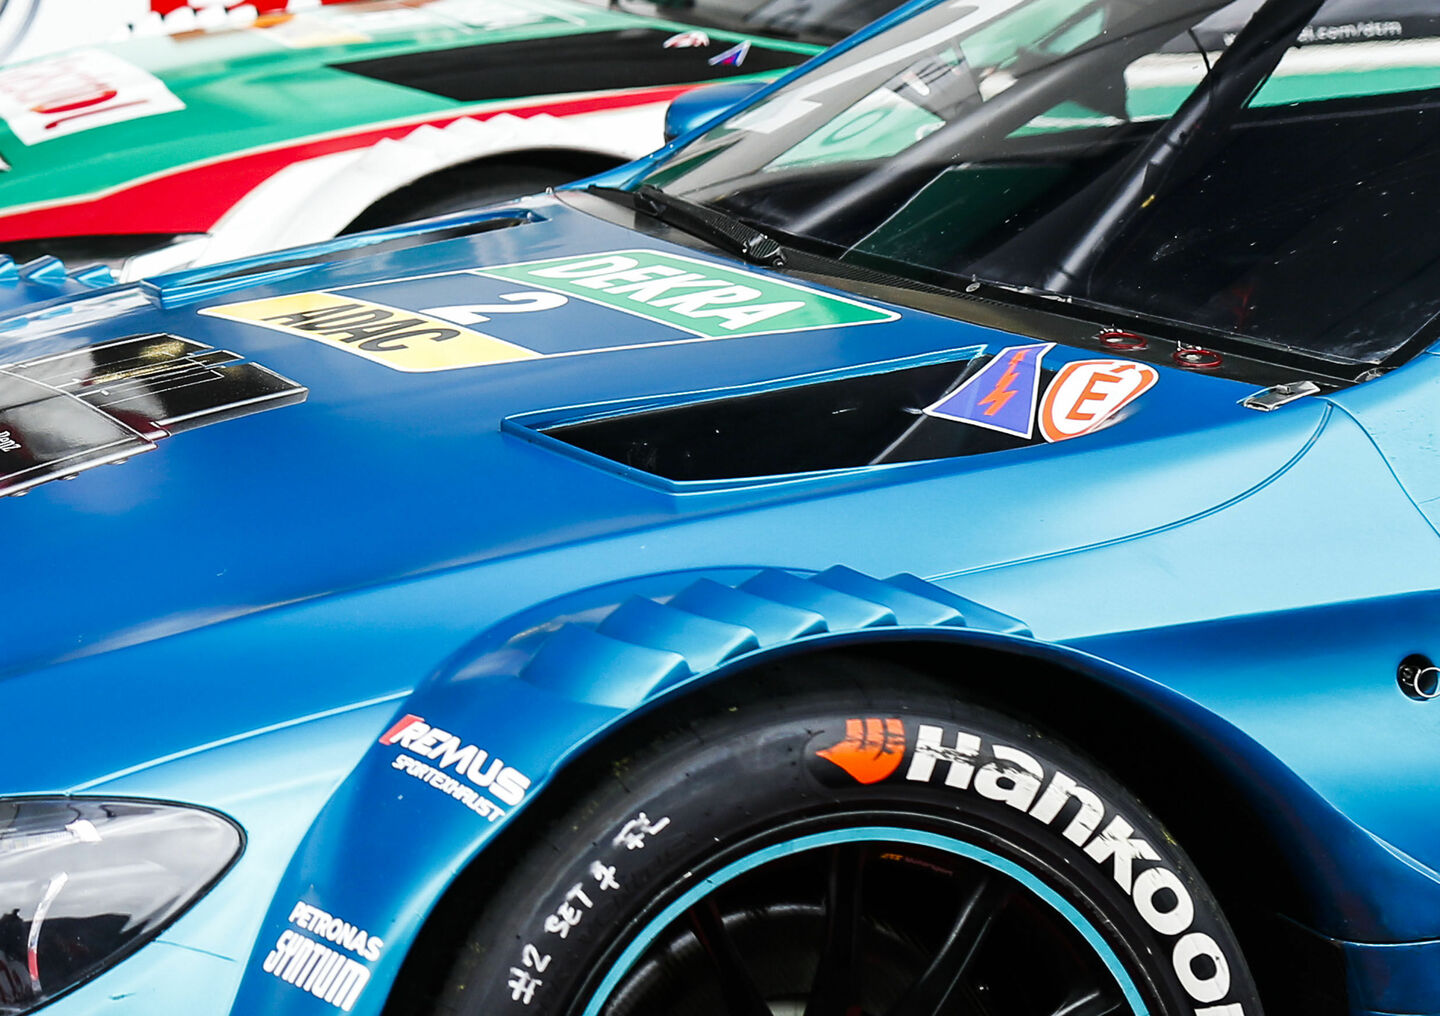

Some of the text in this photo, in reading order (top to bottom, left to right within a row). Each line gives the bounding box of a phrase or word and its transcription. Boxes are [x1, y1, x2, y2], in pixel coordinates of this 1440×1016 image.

[259, 301, 462, 354] ADAC
[417, 290, 570, 324] 2
[538, 254, 807, 332] DEKRA
[1064, 372, 1126, 422] E
[389, 720, 532, 806] REMUS
[391, 753, 506, 823] SPORTEXHAUST
[905, 723, 1250, 1016] Hankoo
[288, 899, 384, 962] PETRONAS
[507, 942, 553, 1006] #2
[544, 882, 594, 940] SET
[262, 928, 372, 1012] SYNTIUM
